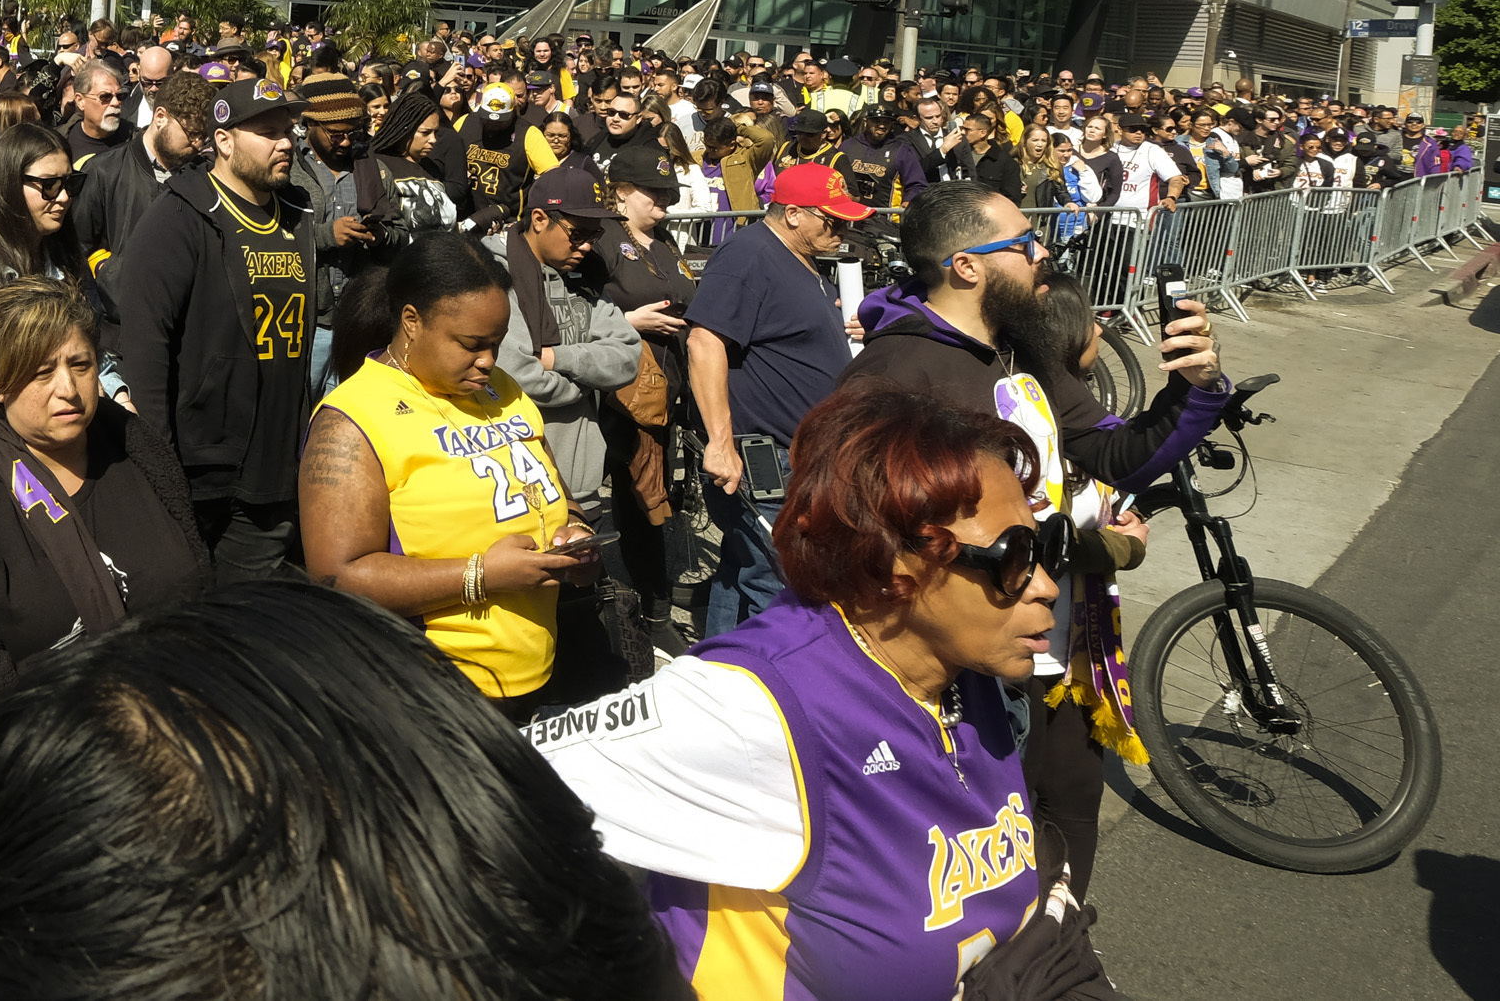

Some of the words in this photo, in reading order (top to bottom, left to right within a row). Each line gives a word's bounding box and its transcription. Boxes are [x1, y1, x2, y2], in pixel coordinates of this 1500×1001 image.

[1387, 20, 1416, 31] Drive
[467, 143, 511, 169] LAKERS
[851, 159, 887, 178] LAKERS
[688, 261, 707, 269] POLIC
[252, 293, 306, 360] 24
[1024, 379, 1041, 403] 8
[395, 407, 415, 416] adidas
[433, 414, 536, 459] LAKERS
[11, 458, 70, 524] A
[471, 440, 561, 524] 24
[604, 692, 650, 732] LOS
[862, 760, 901, 776] adidas
[923, 792, 1037, 932] LAKERS
